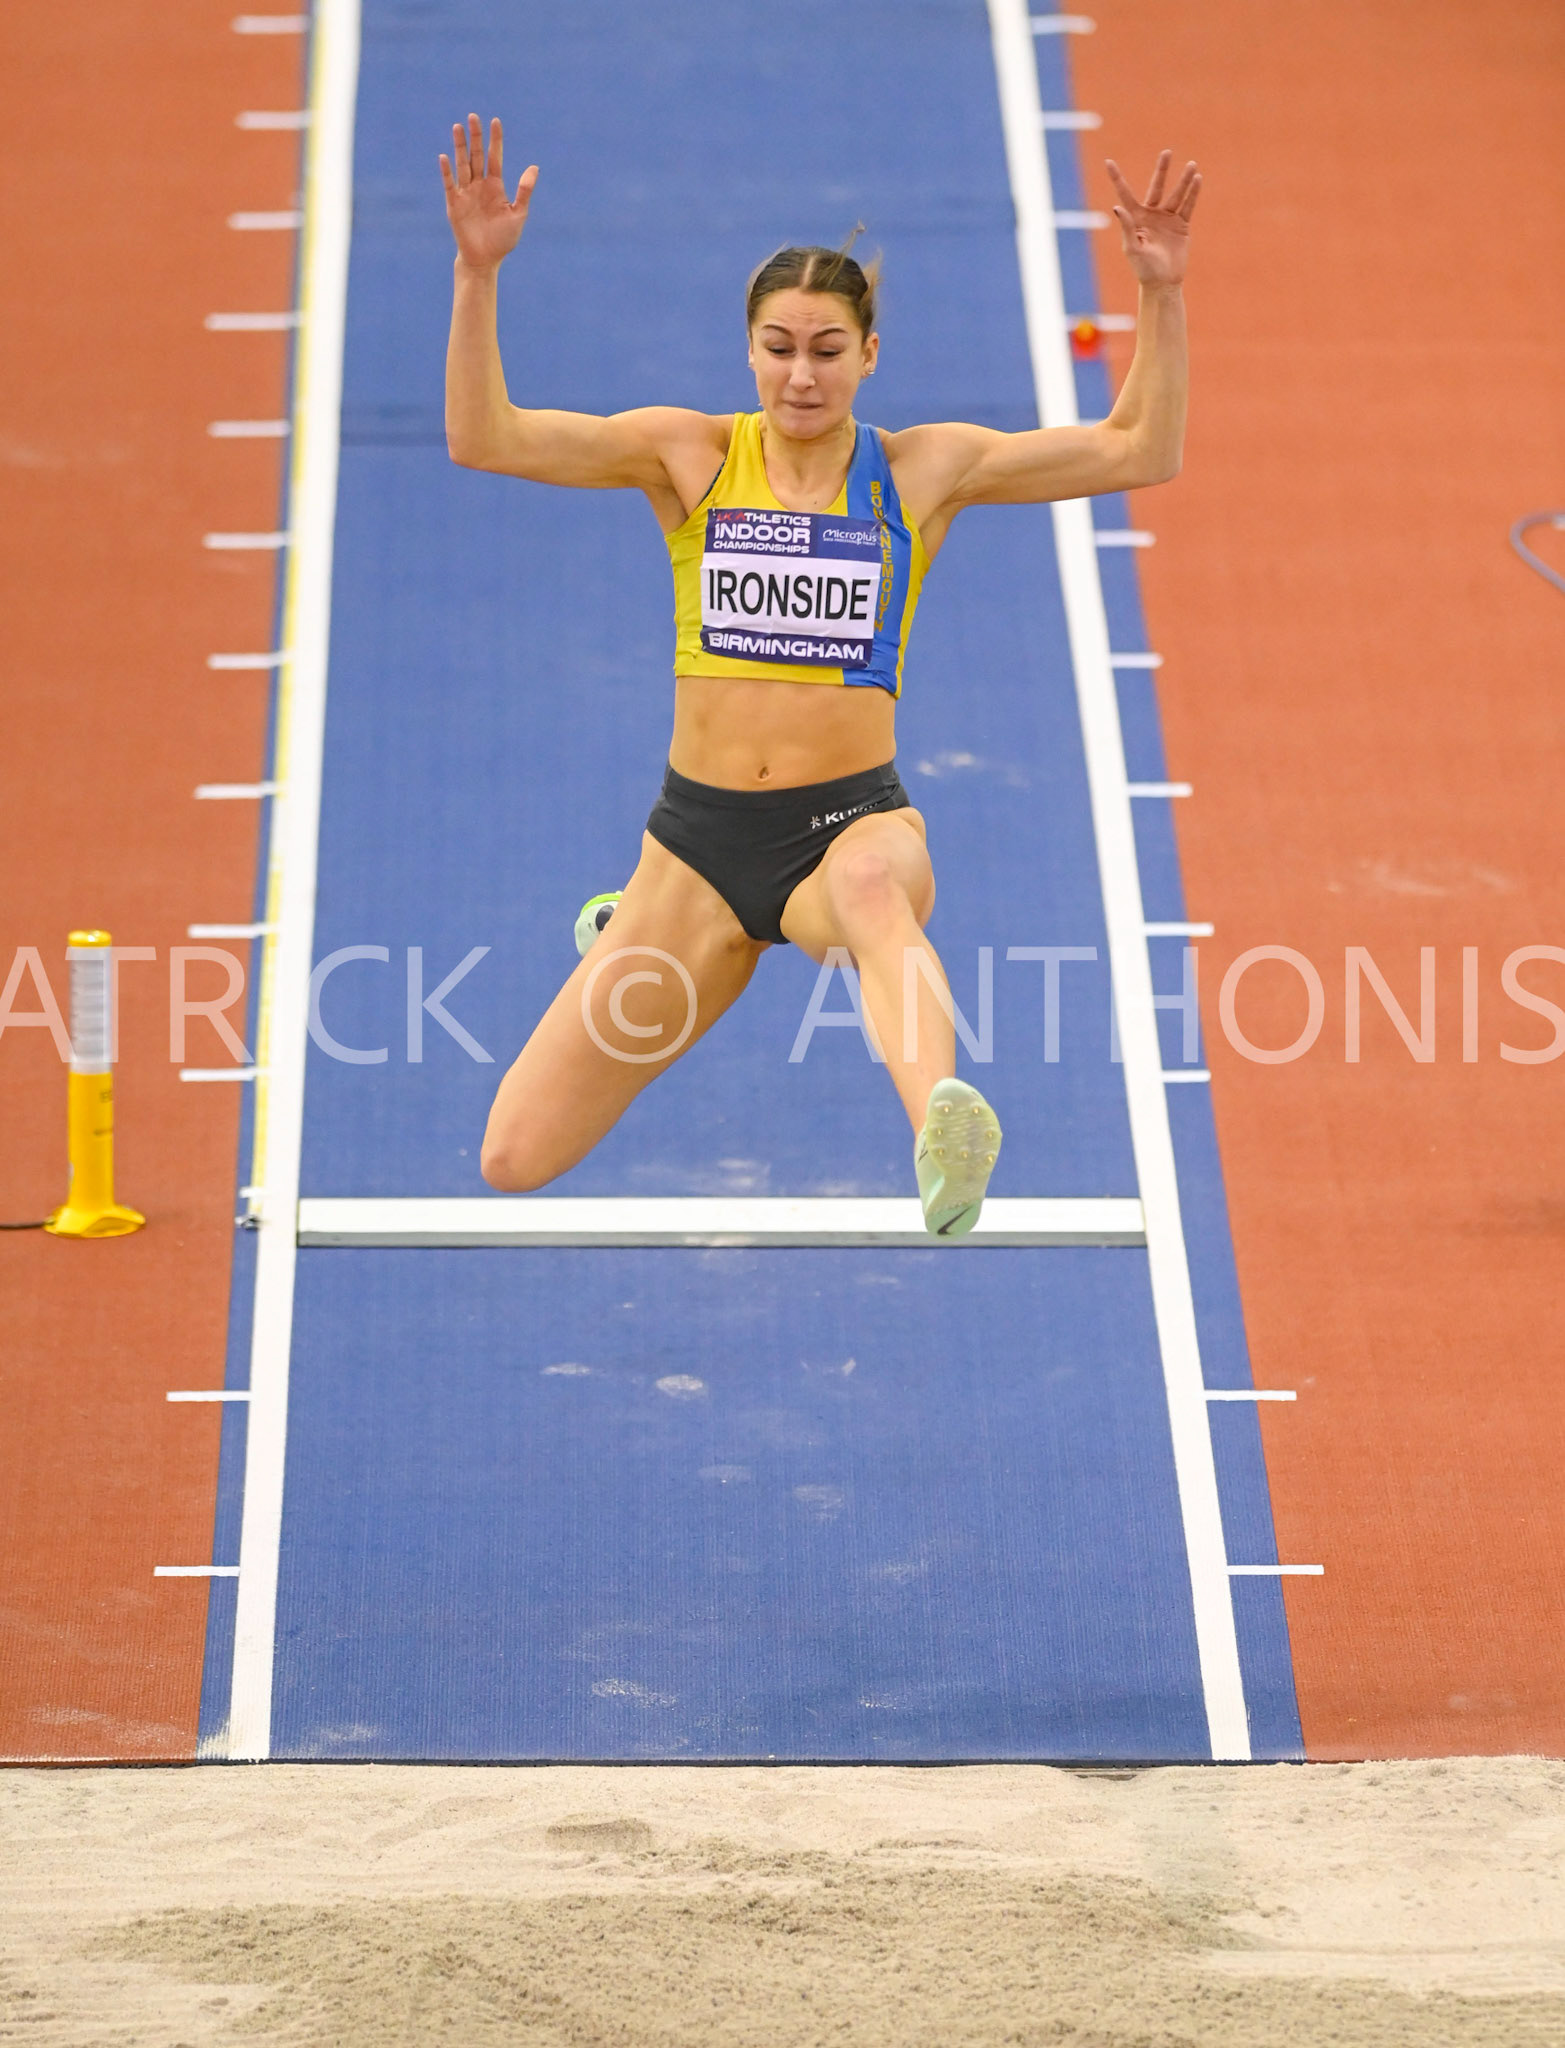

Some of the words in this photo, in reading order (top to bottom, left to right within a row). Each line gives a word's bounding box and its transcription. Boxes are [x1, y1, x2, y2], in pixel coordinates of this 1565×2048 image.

[735, 511, 812, 526] ATHLETICS
[714, 522, 811, 544] INDOOR
[713, 540, 810, 554] CHAMPIONSHIPS
[708, 568, 871, 620] IRONSIDE
[709, 632, 865, 661] BIRMINGHAM
